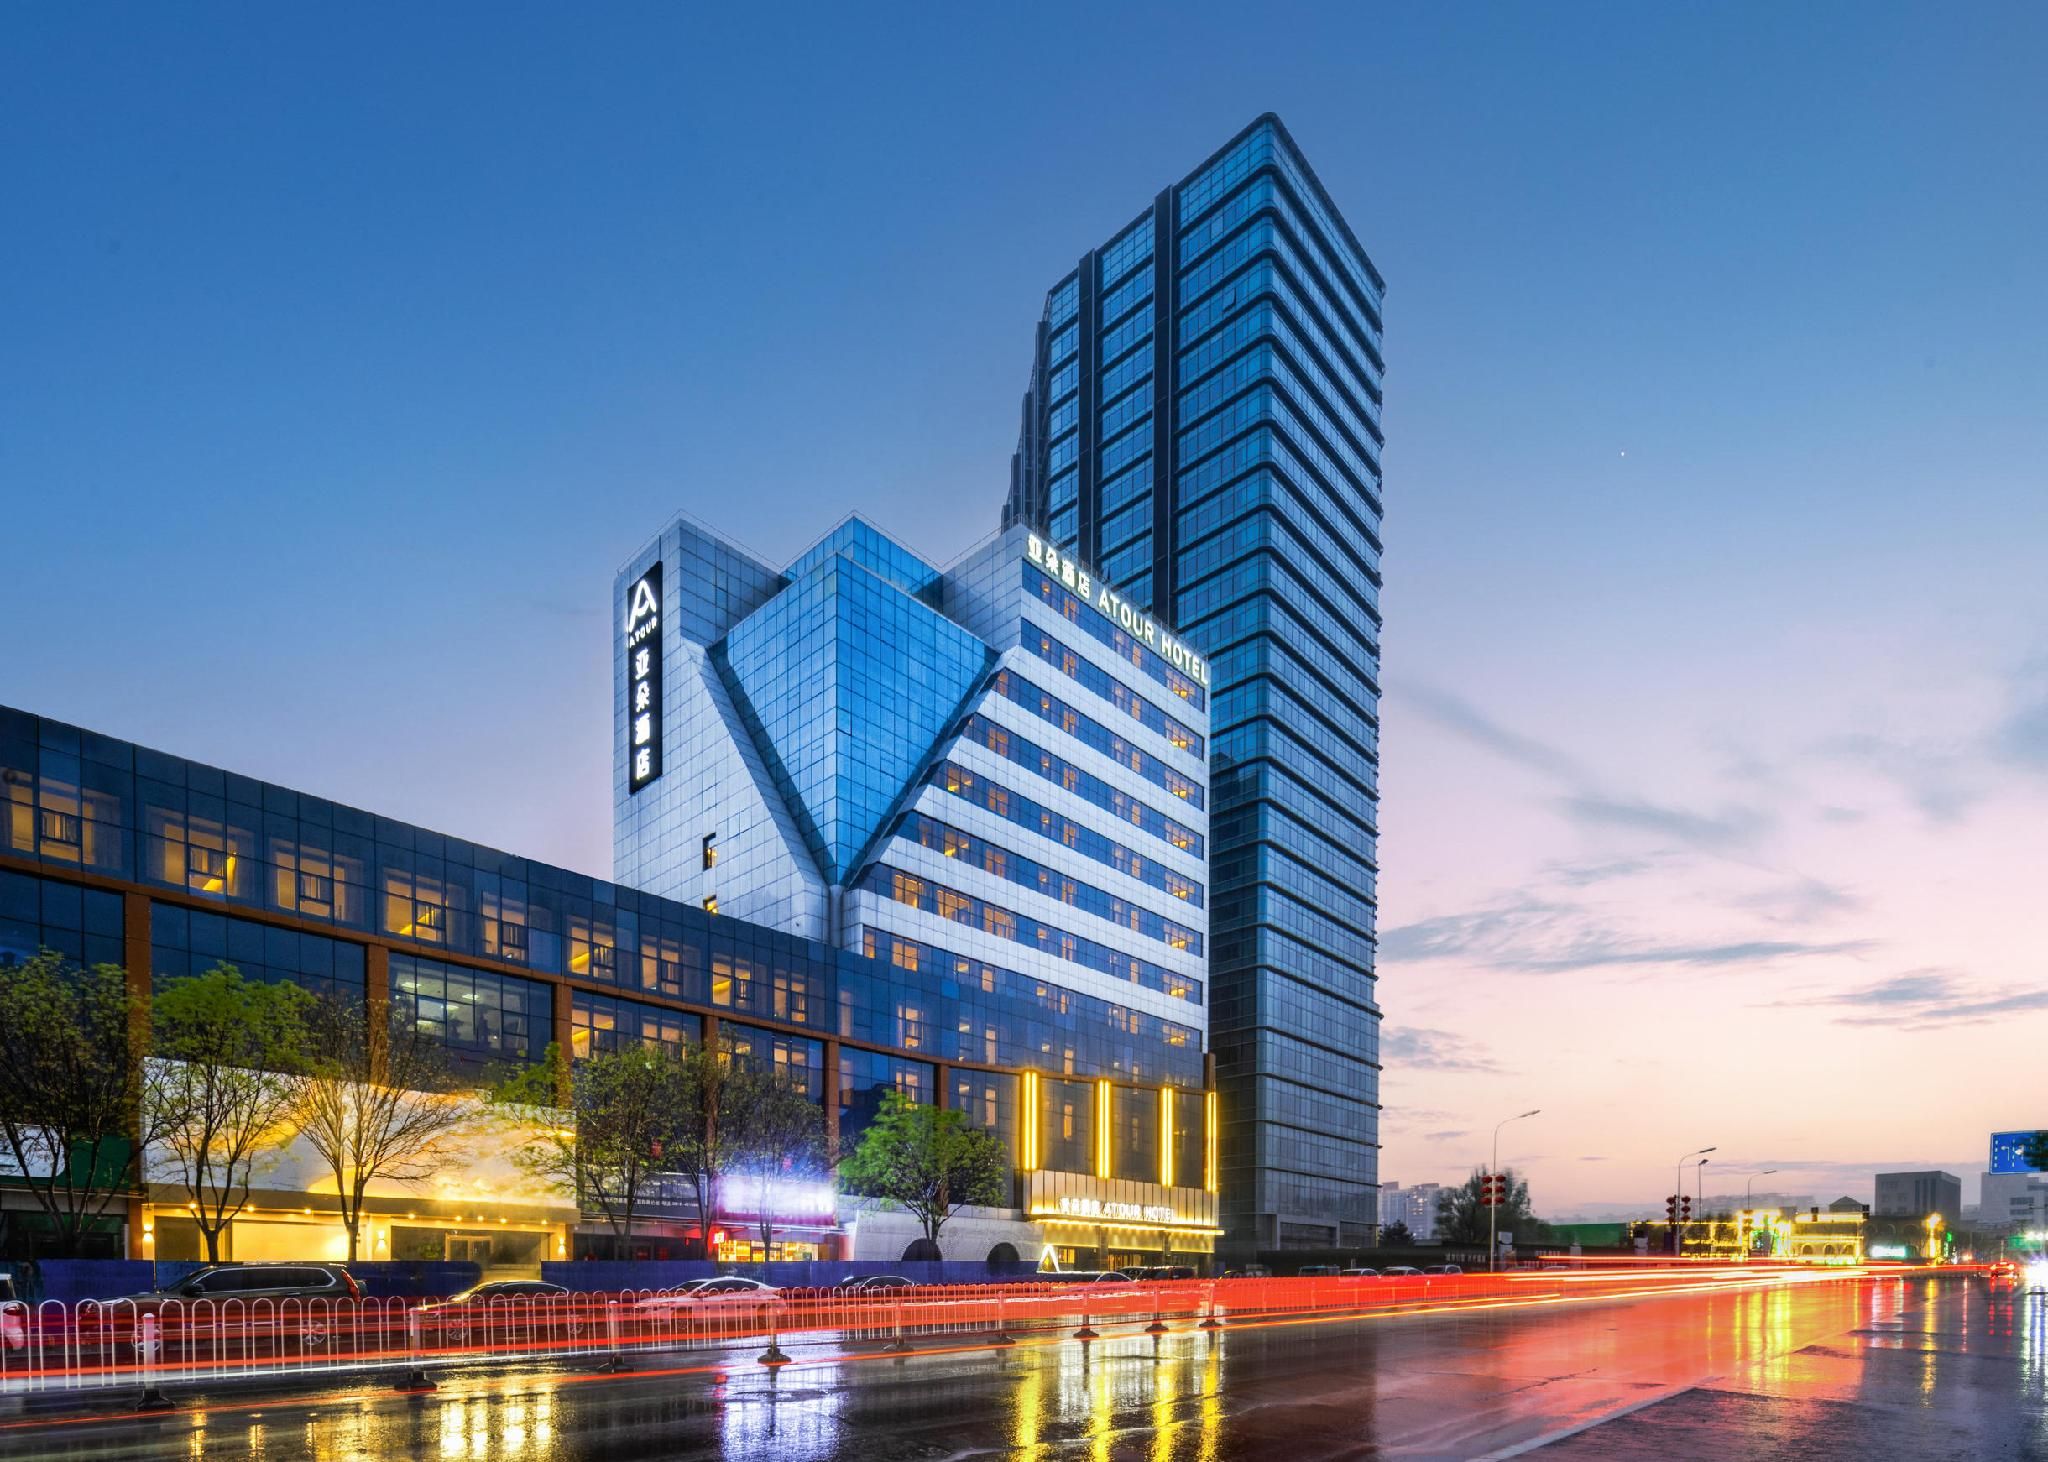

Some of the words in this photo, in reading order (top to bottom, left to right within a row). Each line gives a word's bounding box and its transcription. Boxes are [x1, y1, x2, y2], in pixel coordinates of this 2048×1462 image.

[629, 616, 657, 649] ATOUR
[1099, 587, 1154, 645] ATOUR
[1161, 633, 1209, 685] HOTEL
